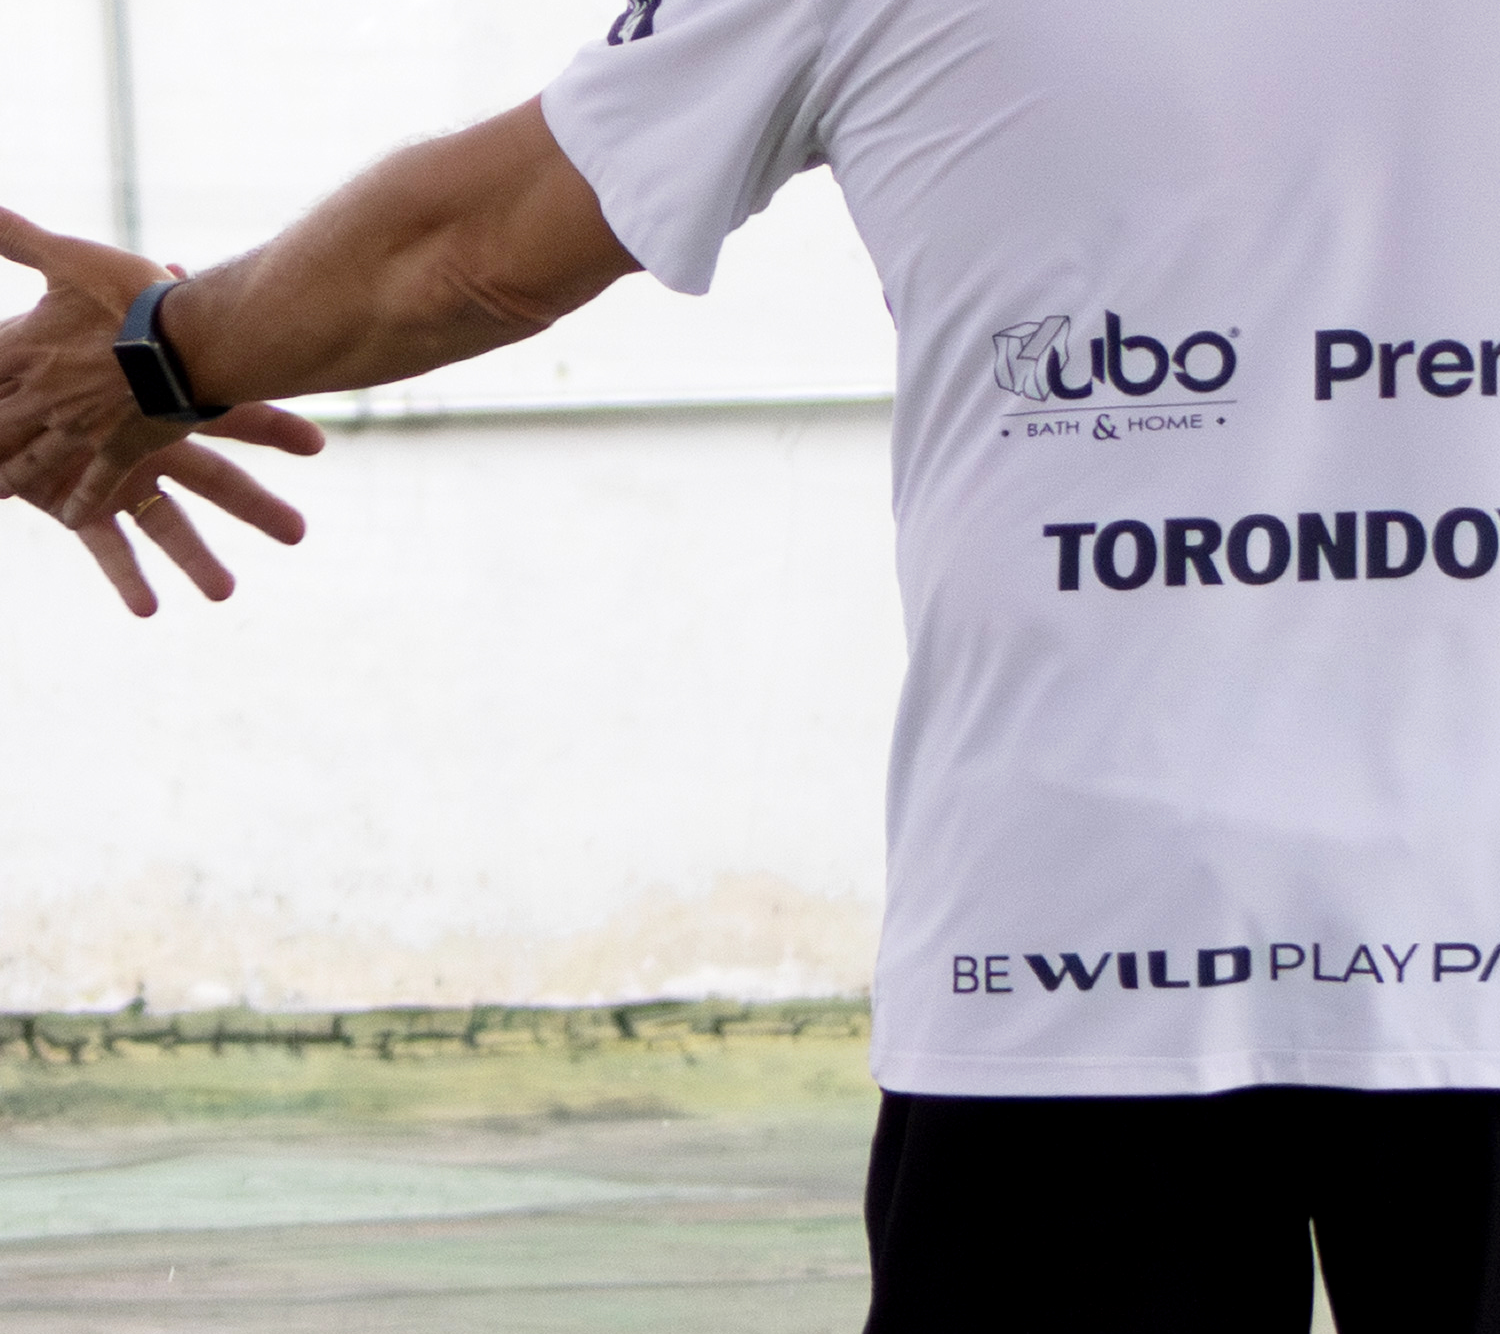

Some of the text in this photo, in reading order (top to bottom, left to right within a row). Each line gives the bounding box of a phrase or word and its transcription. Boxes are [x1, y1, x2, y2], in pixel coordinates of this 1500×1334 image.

[1027, 413, 1203, 440] BATH & HOME
[953, 955, 1013, 994] BE
[1025, 947, 1251, 991] WILD
[1270, 943, 1417, 983] PLAY
